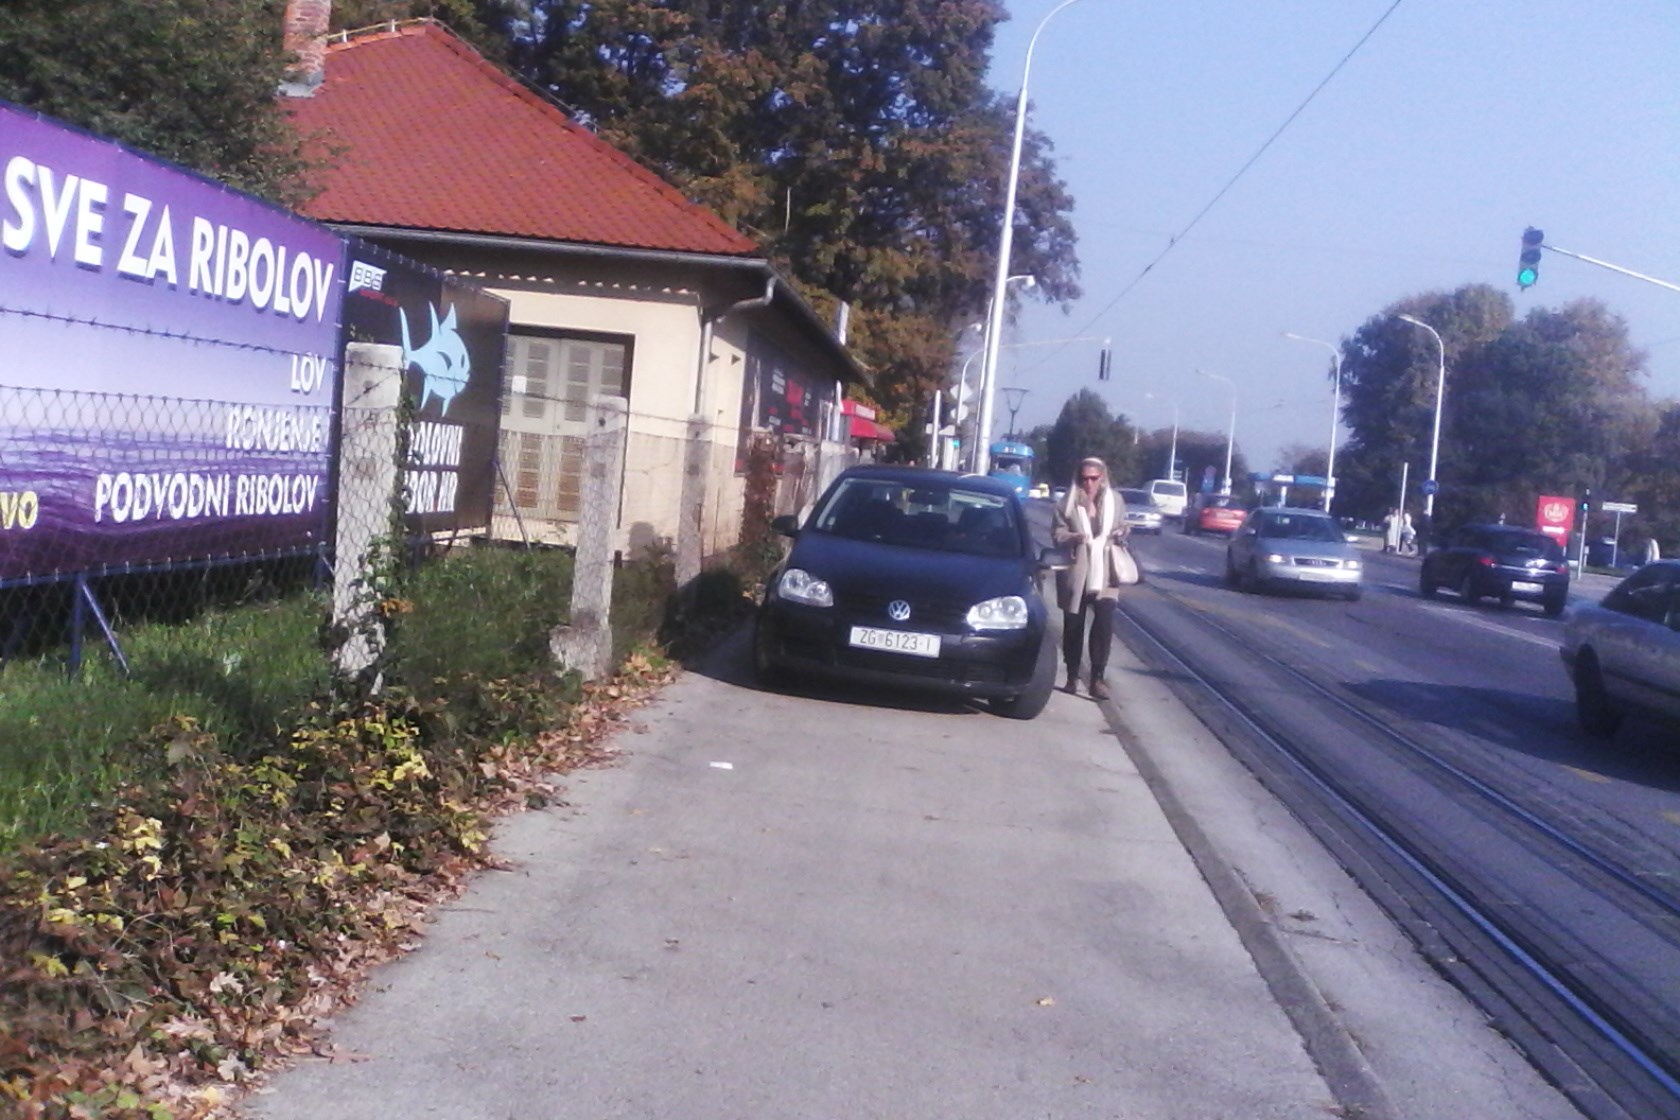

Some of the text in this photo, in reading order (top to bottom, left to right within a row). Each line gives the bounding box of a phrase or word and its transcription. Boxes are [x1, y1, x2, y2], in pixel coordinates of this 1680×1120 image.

[3, 156, 334, 323] SVE ZA RIBOLOV
[291, 352, 326, 392] LOV
[95, 472, 318, 523] PODVODNI RIBOLOV
